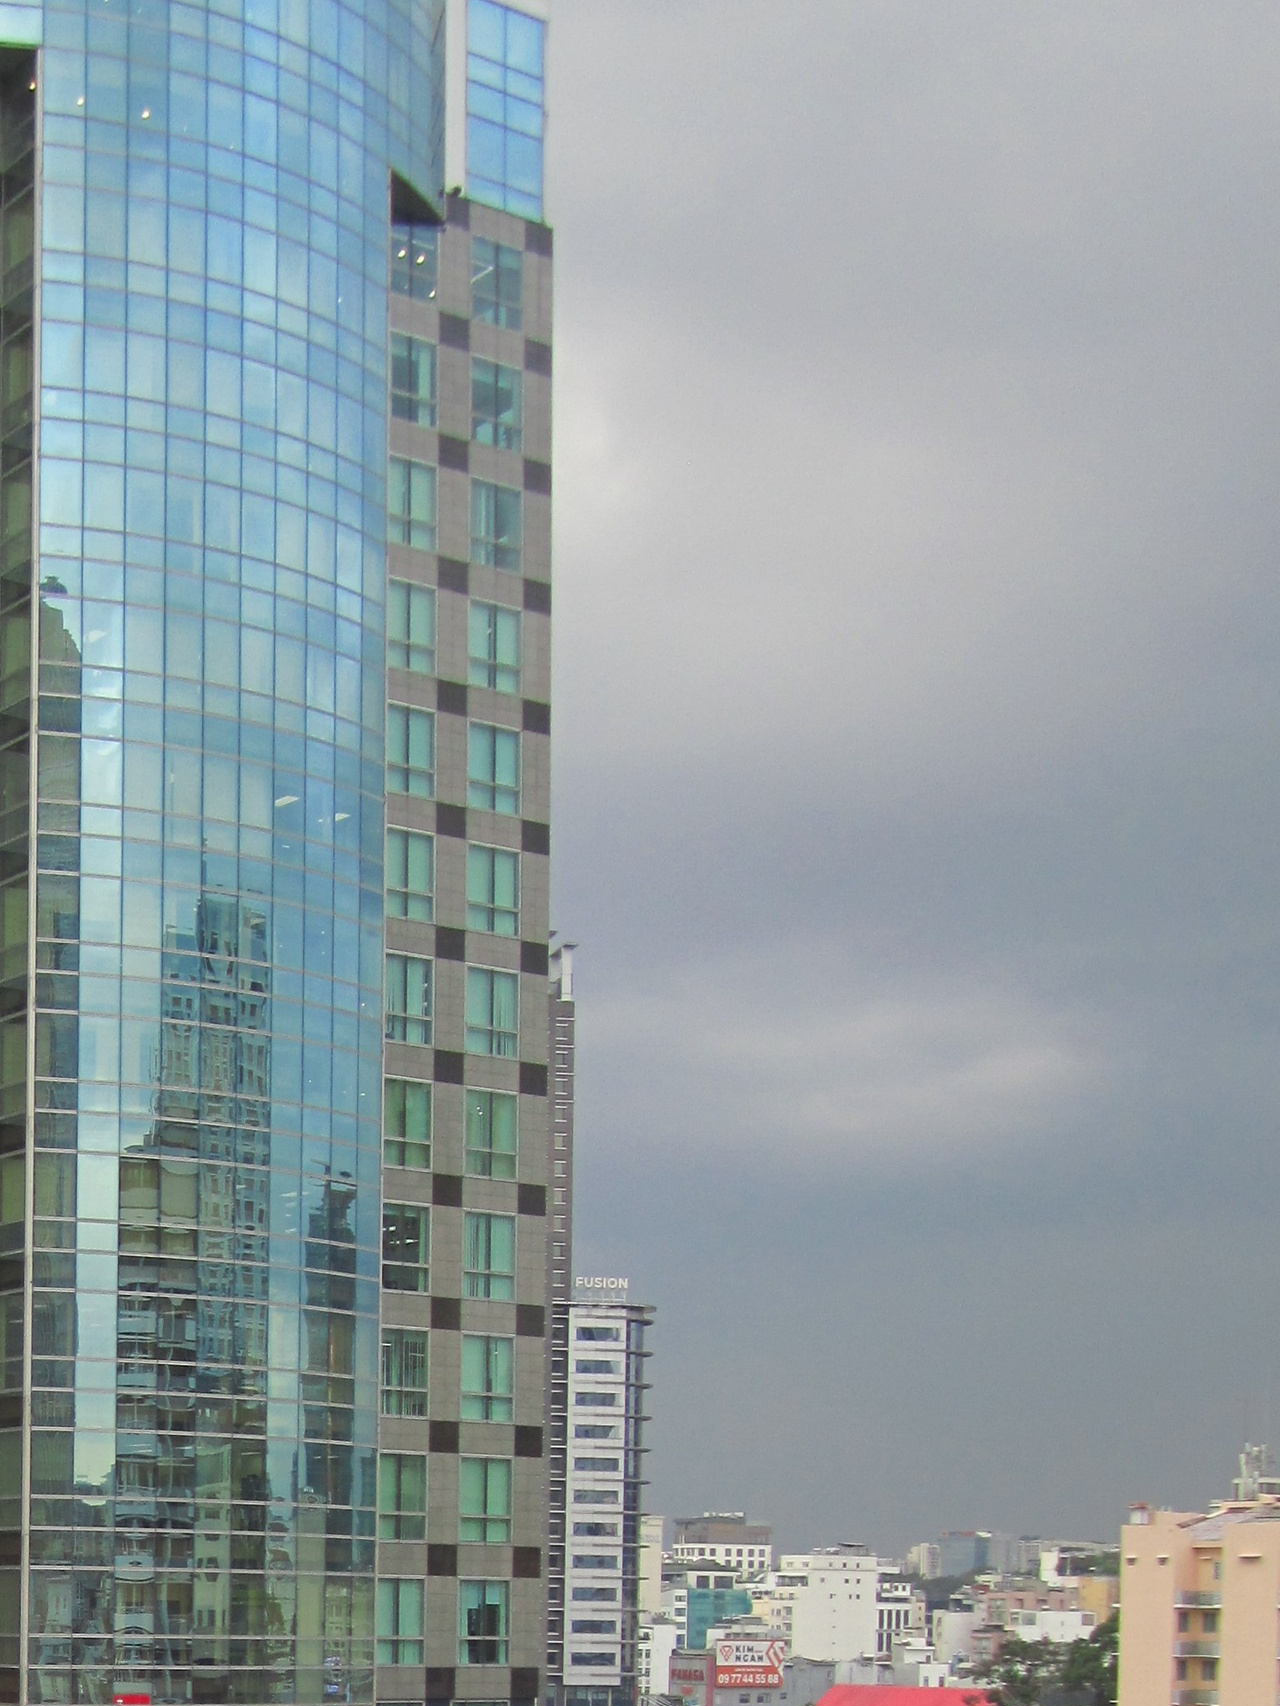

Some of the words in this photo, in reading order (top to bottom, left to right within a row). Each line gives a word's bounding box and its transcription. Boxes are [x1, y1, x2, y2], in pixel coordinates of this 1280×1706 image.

[575, 1276, 628, 1289] FUSION
[735, 1645, 754, 1653] KIM
[718, 1674, 729, 1684] 09
[731, 1674, 741, 1684] 77
[742, 1674, 753, 1684] 44
[755, 1674, 766, 1684] 55
